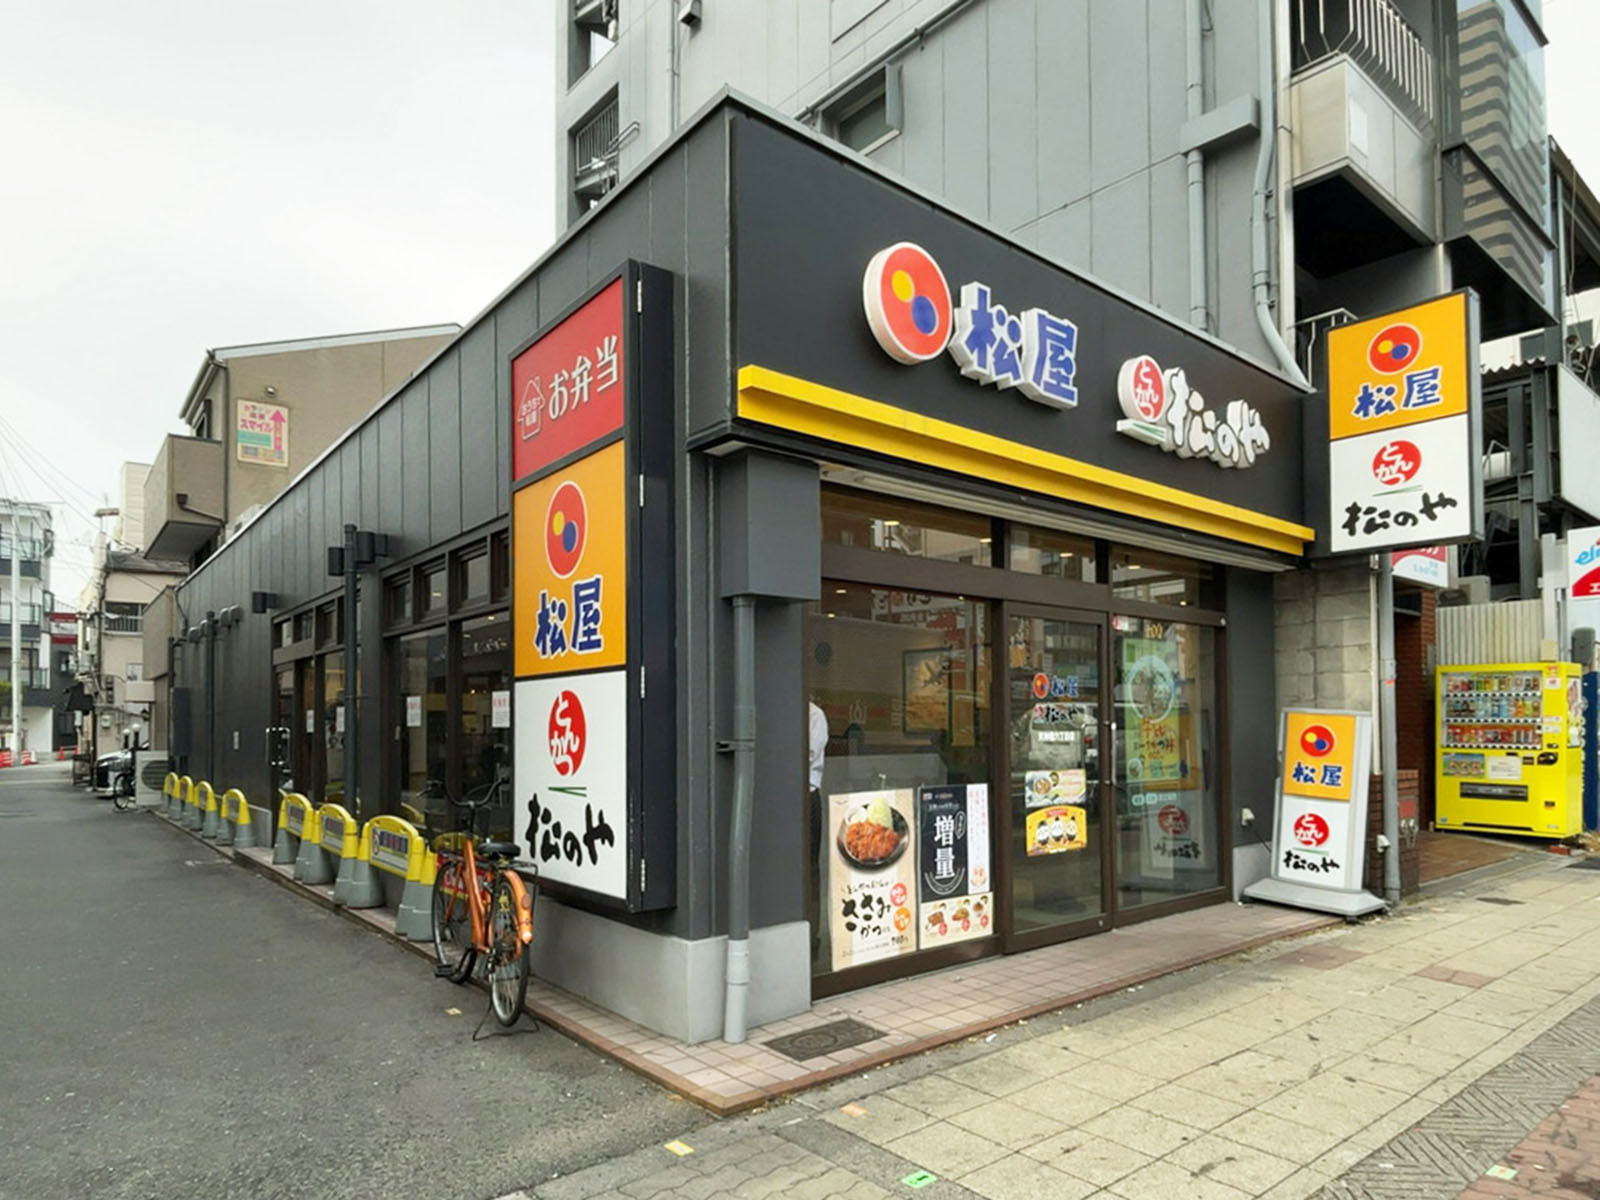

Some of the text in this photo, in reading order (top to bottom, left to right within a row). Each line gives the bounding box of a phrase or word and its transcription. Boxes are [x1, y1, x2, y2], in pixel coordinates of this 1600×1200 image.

[548, 335, 618, 420] お弁当
[949, 282, 1078, 410] 松屋
[1165, 367, 1270, 467] 松のや
[1352, 367, 1442, 418] 松屋
[1375, 442, 1413, 484] とんかつ
[1342, 492, 1457, 536] 松のや
[534, 574, 603, 659] 松屋
[551, 691, 580, 776] とんかつ
[1292, 762, 1342, 787] 松屋
[525, 793, 614, 867] 松のや
[934, 814, 956, 879] 増量
[1283, 850, 1340, 874] 松のや
[842, 892, 891, 932] ささみ
